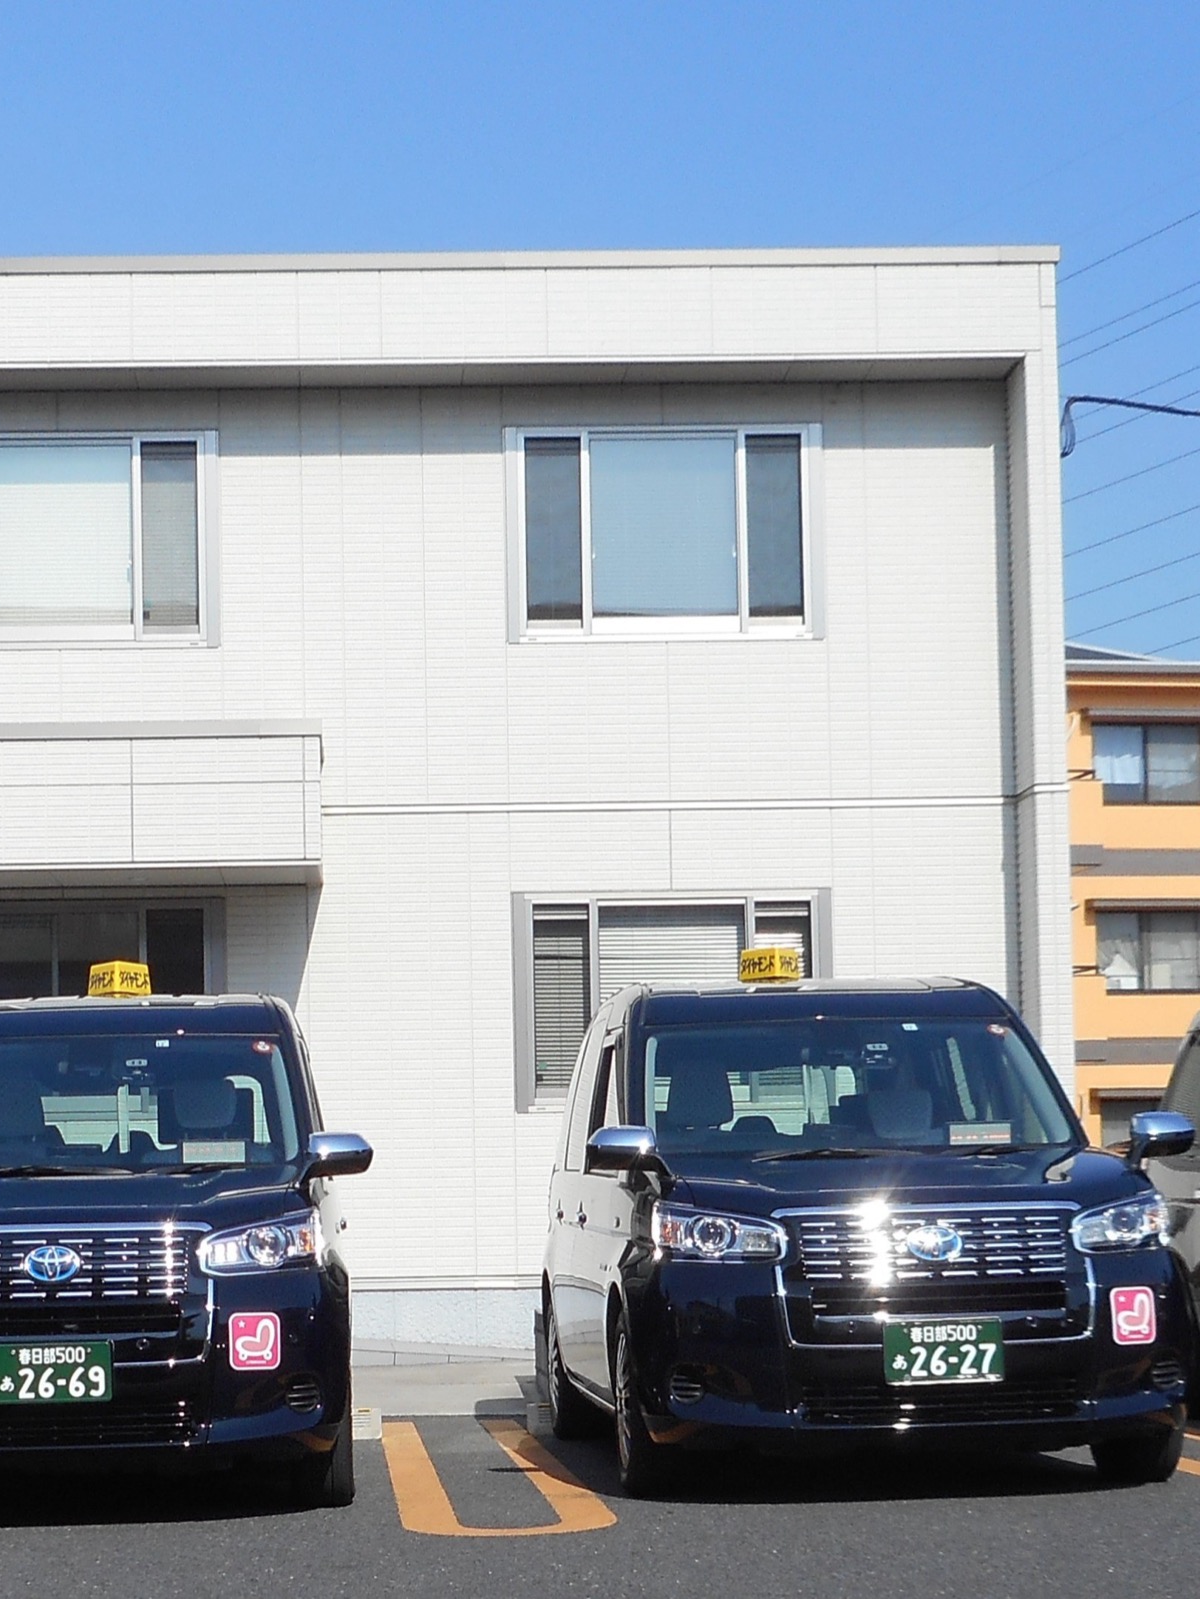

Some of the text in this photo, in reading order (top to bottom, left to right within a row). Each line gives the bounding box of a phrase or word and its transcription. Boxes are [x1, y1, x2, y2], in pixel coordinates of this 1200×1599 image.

[892, 1343, 997, 1377] あ 26-27
[0, 1365, 106, 1399] あ 26-69
